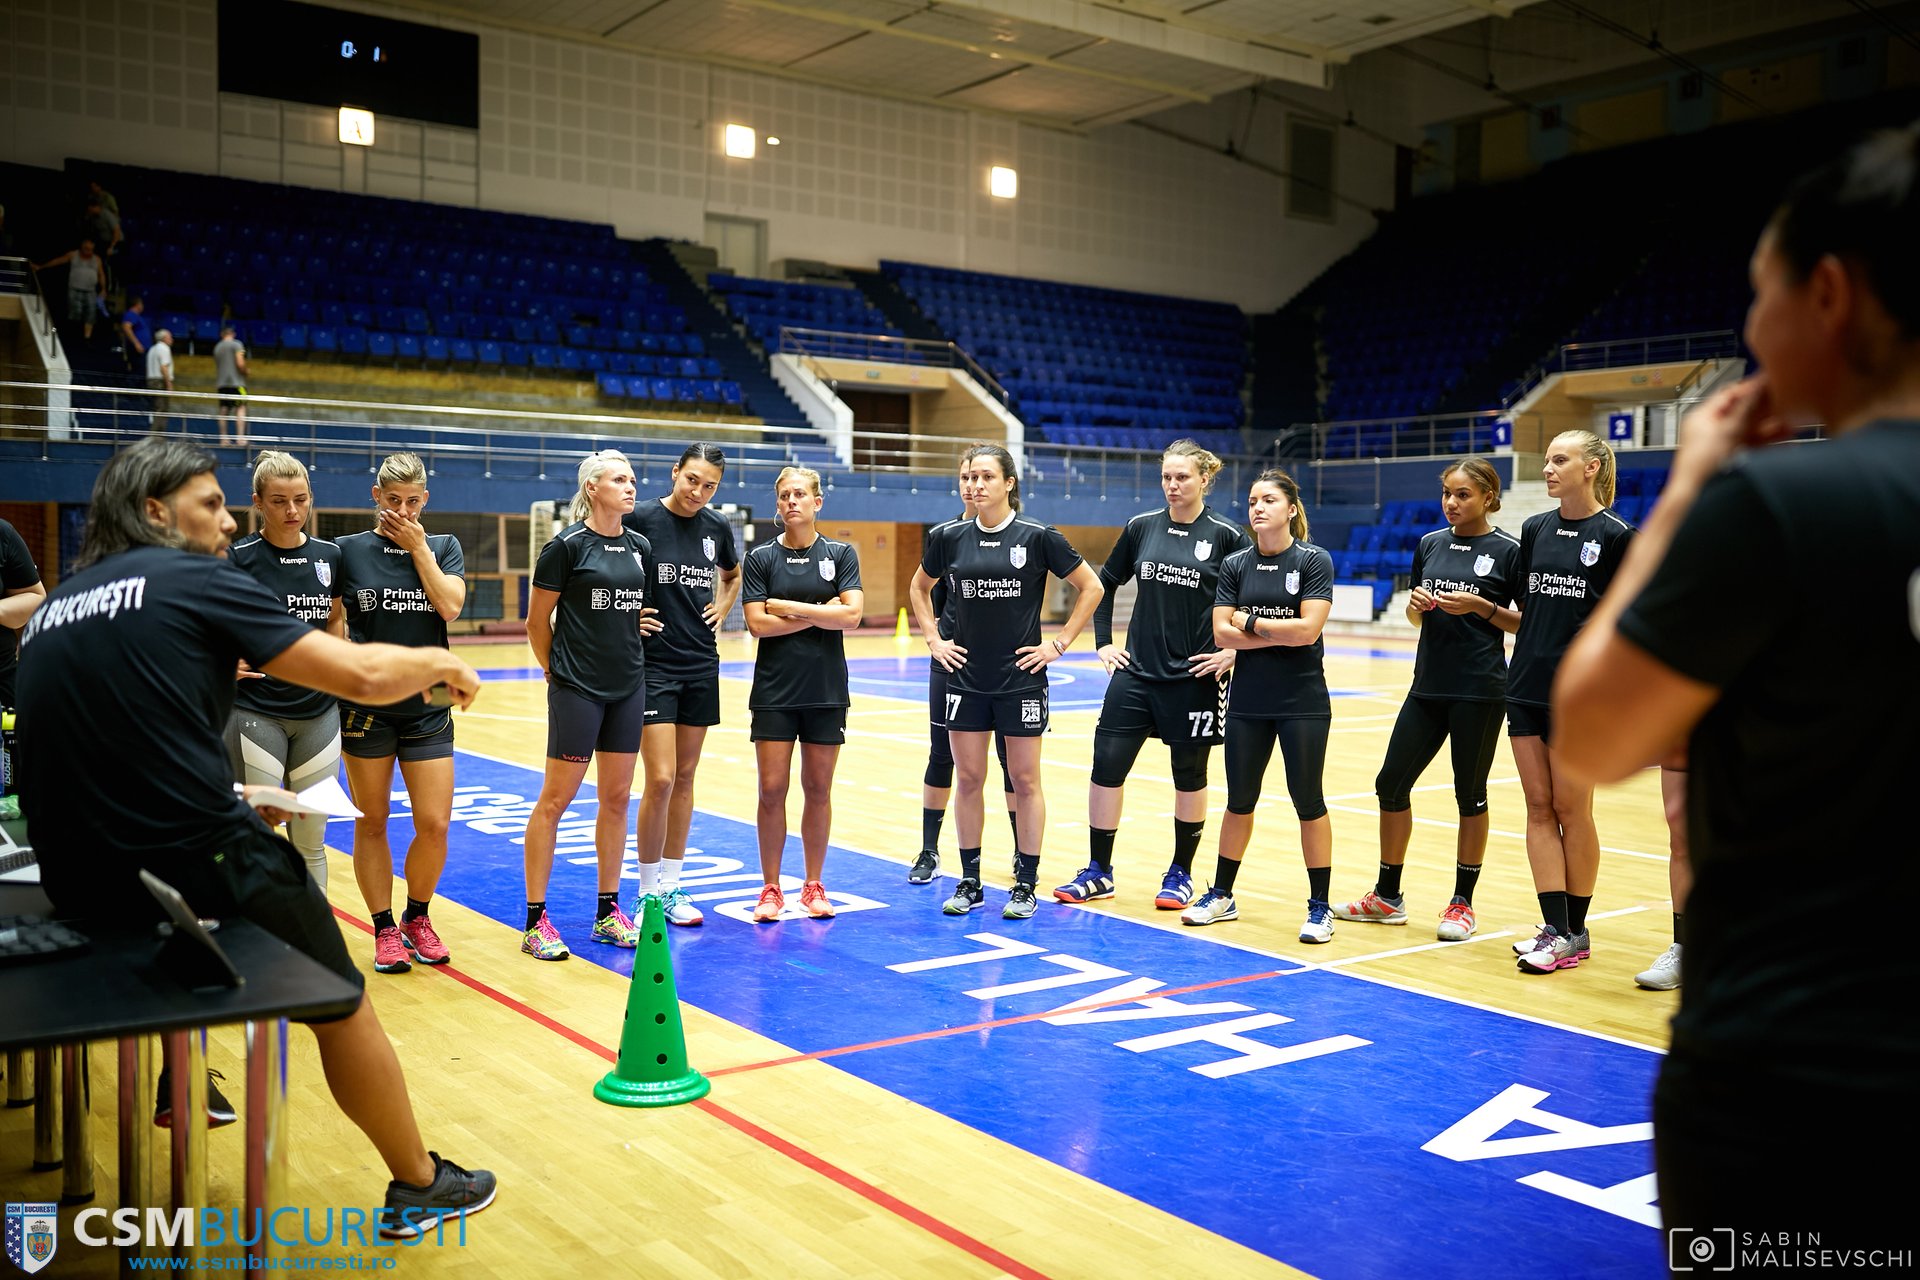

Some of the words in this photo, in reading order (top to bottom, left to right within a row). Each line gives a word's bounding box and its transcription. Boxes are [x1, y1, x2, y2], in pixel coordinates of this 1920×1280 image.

[1614, 420, 1627, 436] 2
[1496, 427, 1506, 443] 1
[1167, 527, 1189, 537] Kempa
[1556, 528, 1579, 538] Kempa
[604, 544, 625, 553] Kempa
[979, 540, 1001, 548] Kempa
[1449, 543, 1472, 552] Kempa
[279, 557, 308, 565] Kempa
[786, 557, 810, 565] Kempa
[1157, 562, 1201, 579] Primăria
[1256, 563, 1279, 573] Kempa
[977, 578, 1022, 588] Primăria
[1155, 572, 1200, 589] Capitalei
[1434, 578, 1480, 595] Primăria
[1542, 573, 1586, 588] Primăria
[383, 588, 427, 600] Primăr
[977, 588, 1022, 600] Capitalei
[1540, 583, 1586, 599] Capitalei
[287, 593, 333, 607] Primări
[1252, 605, 1295, 616] Primăria
[1188, 711, 1214, 737] 72
[886, 932, 1374, 1080] HALL
